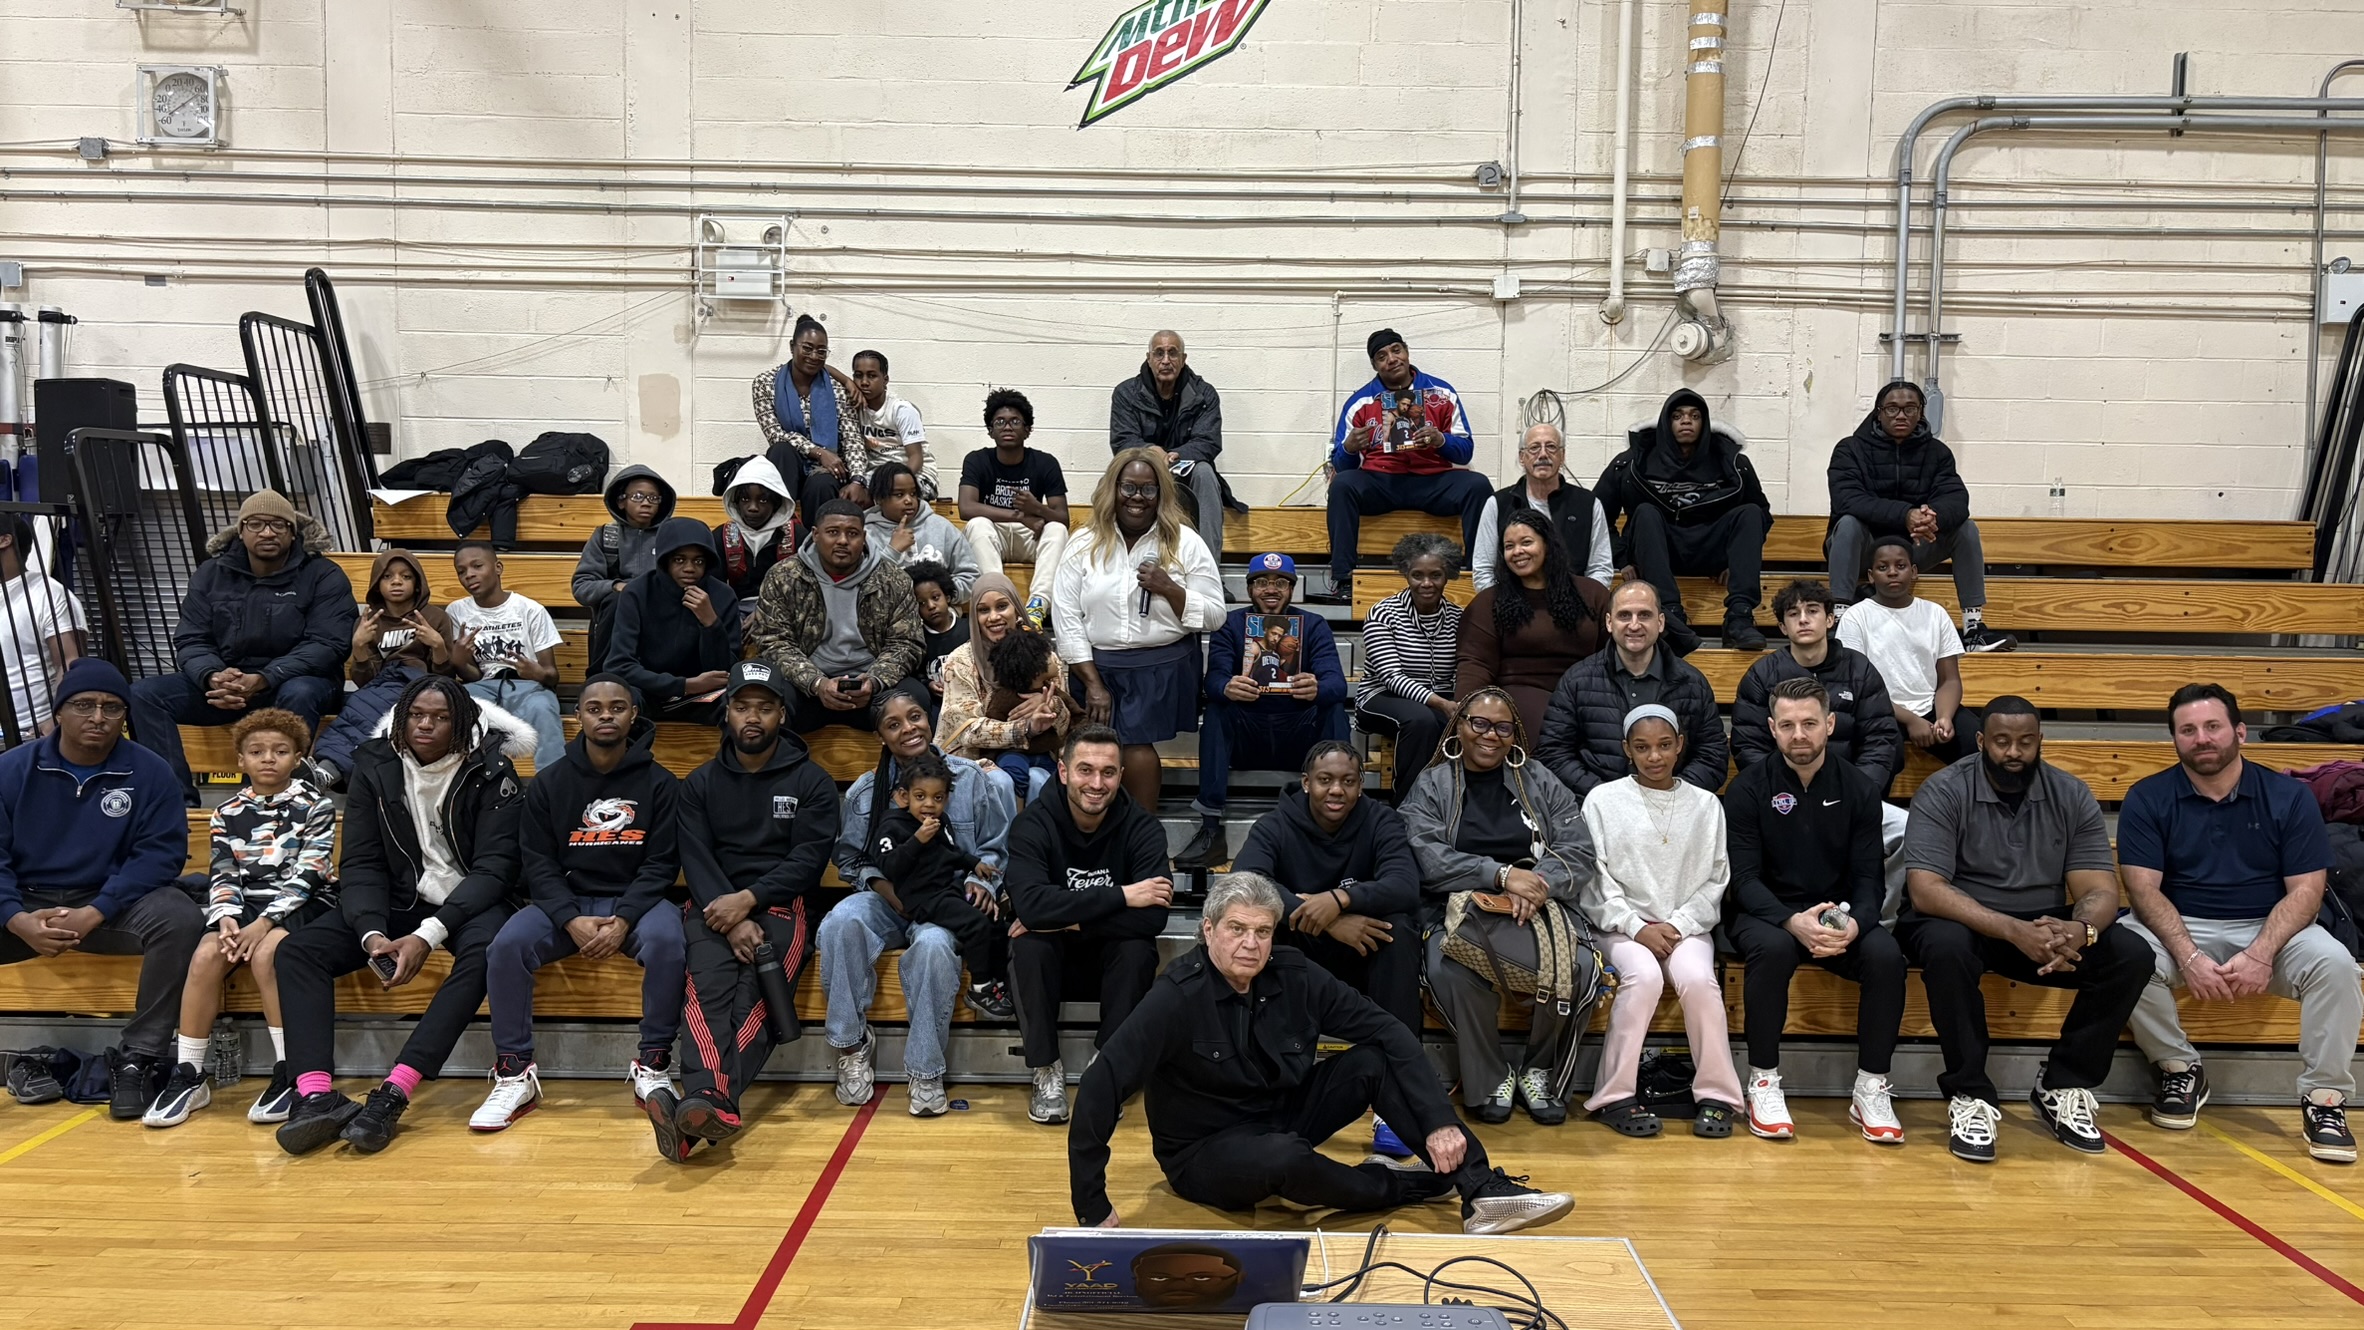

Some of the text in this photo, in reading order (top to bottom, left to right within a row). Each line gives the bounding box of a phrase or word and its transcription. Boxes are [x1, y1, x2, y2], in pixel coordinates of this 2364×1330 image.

[165, 84, 171, 92] 0
[1485, 167, 1497, 184] 2
[482, 622, 522, 631] ATHLETES
[381, 628, 416, 648] NIKE
[1271, 668, 1277, 679] 2
[569, 830, 646, 842] HES
[880, 837, 893, 853] 3
[1066, 867, 1114, 888] Fever
